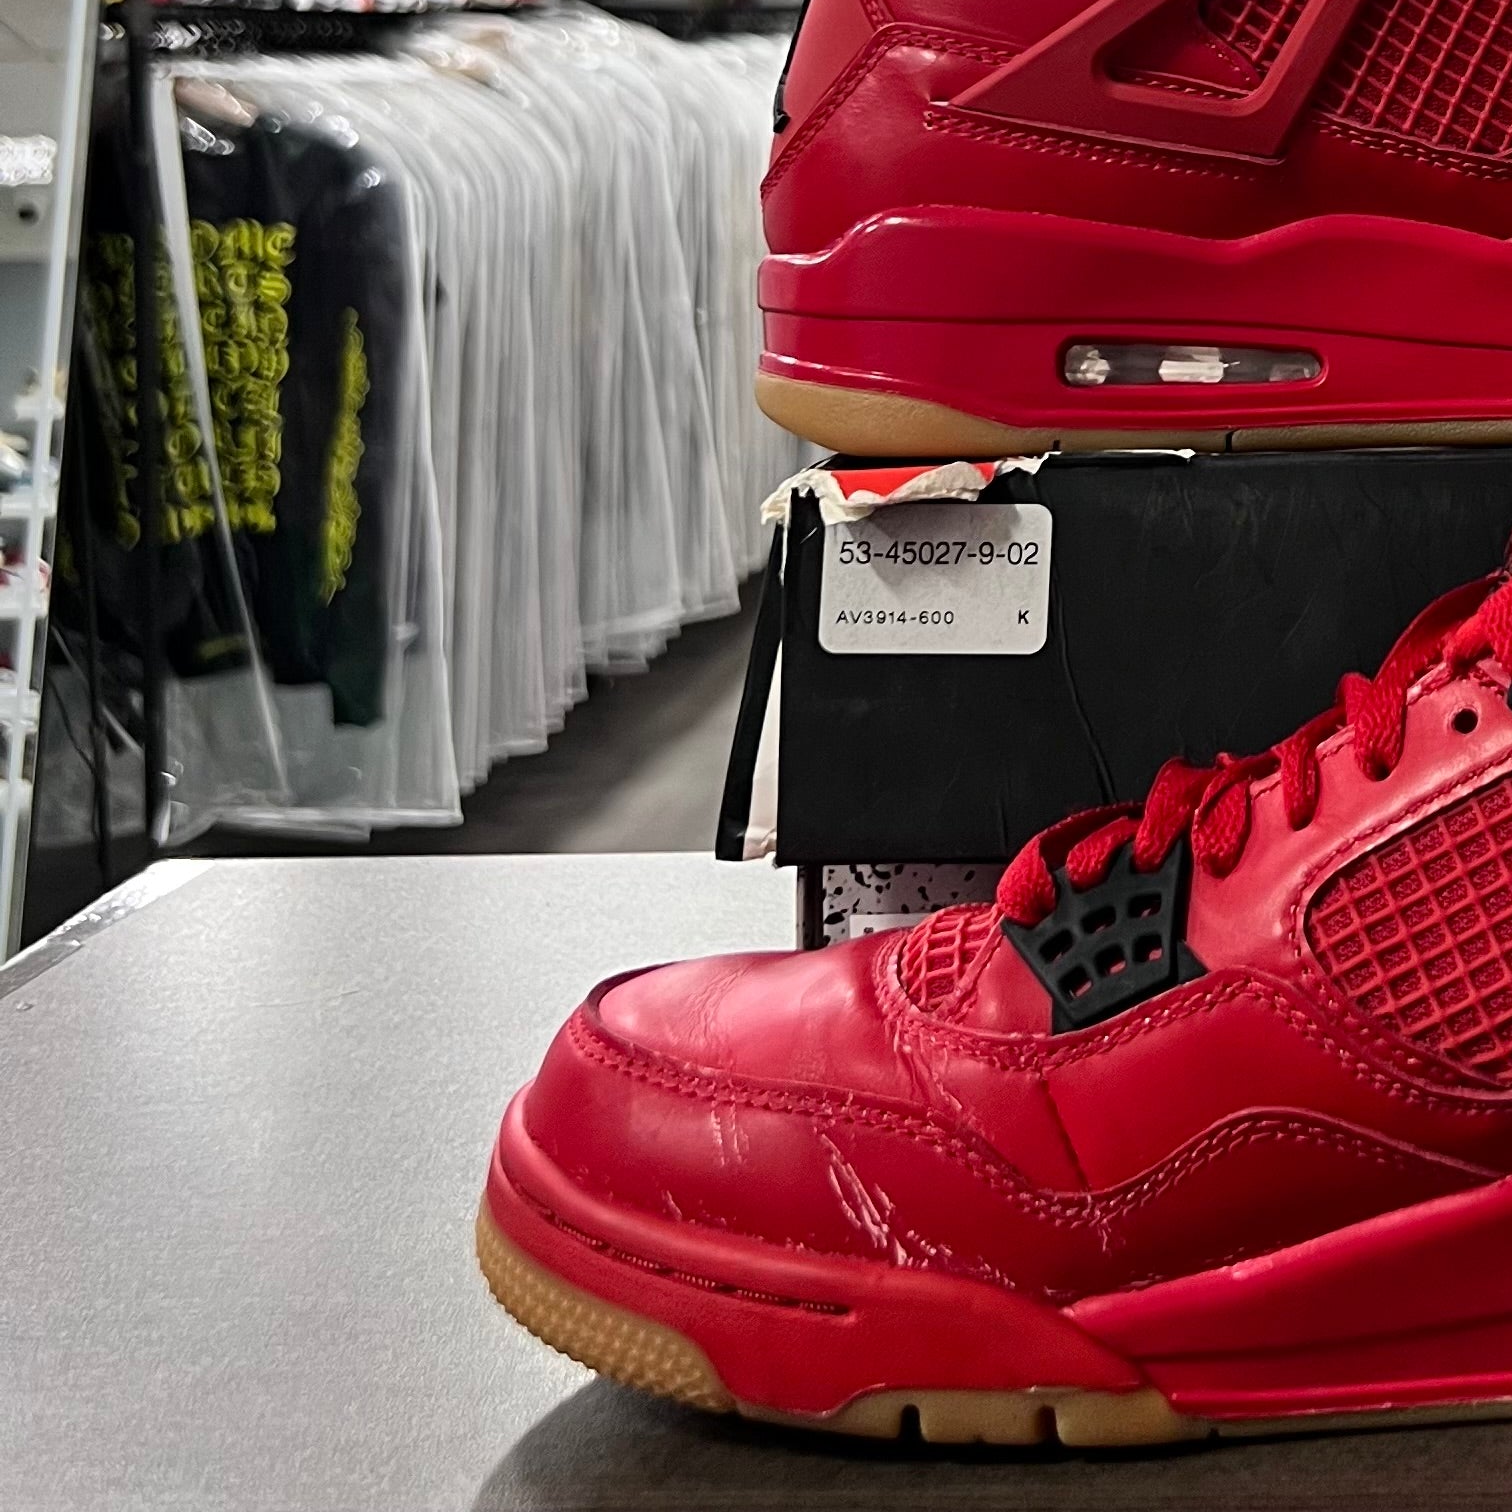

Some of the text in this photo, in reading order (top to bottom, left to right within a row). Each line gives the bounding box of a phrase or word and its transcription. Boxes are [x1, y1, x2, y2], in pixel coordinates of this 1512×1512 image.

[839, 541, 1039, 565] 53-45027-9-02
[836, 609, 1030, 625] AV3914-600 K
